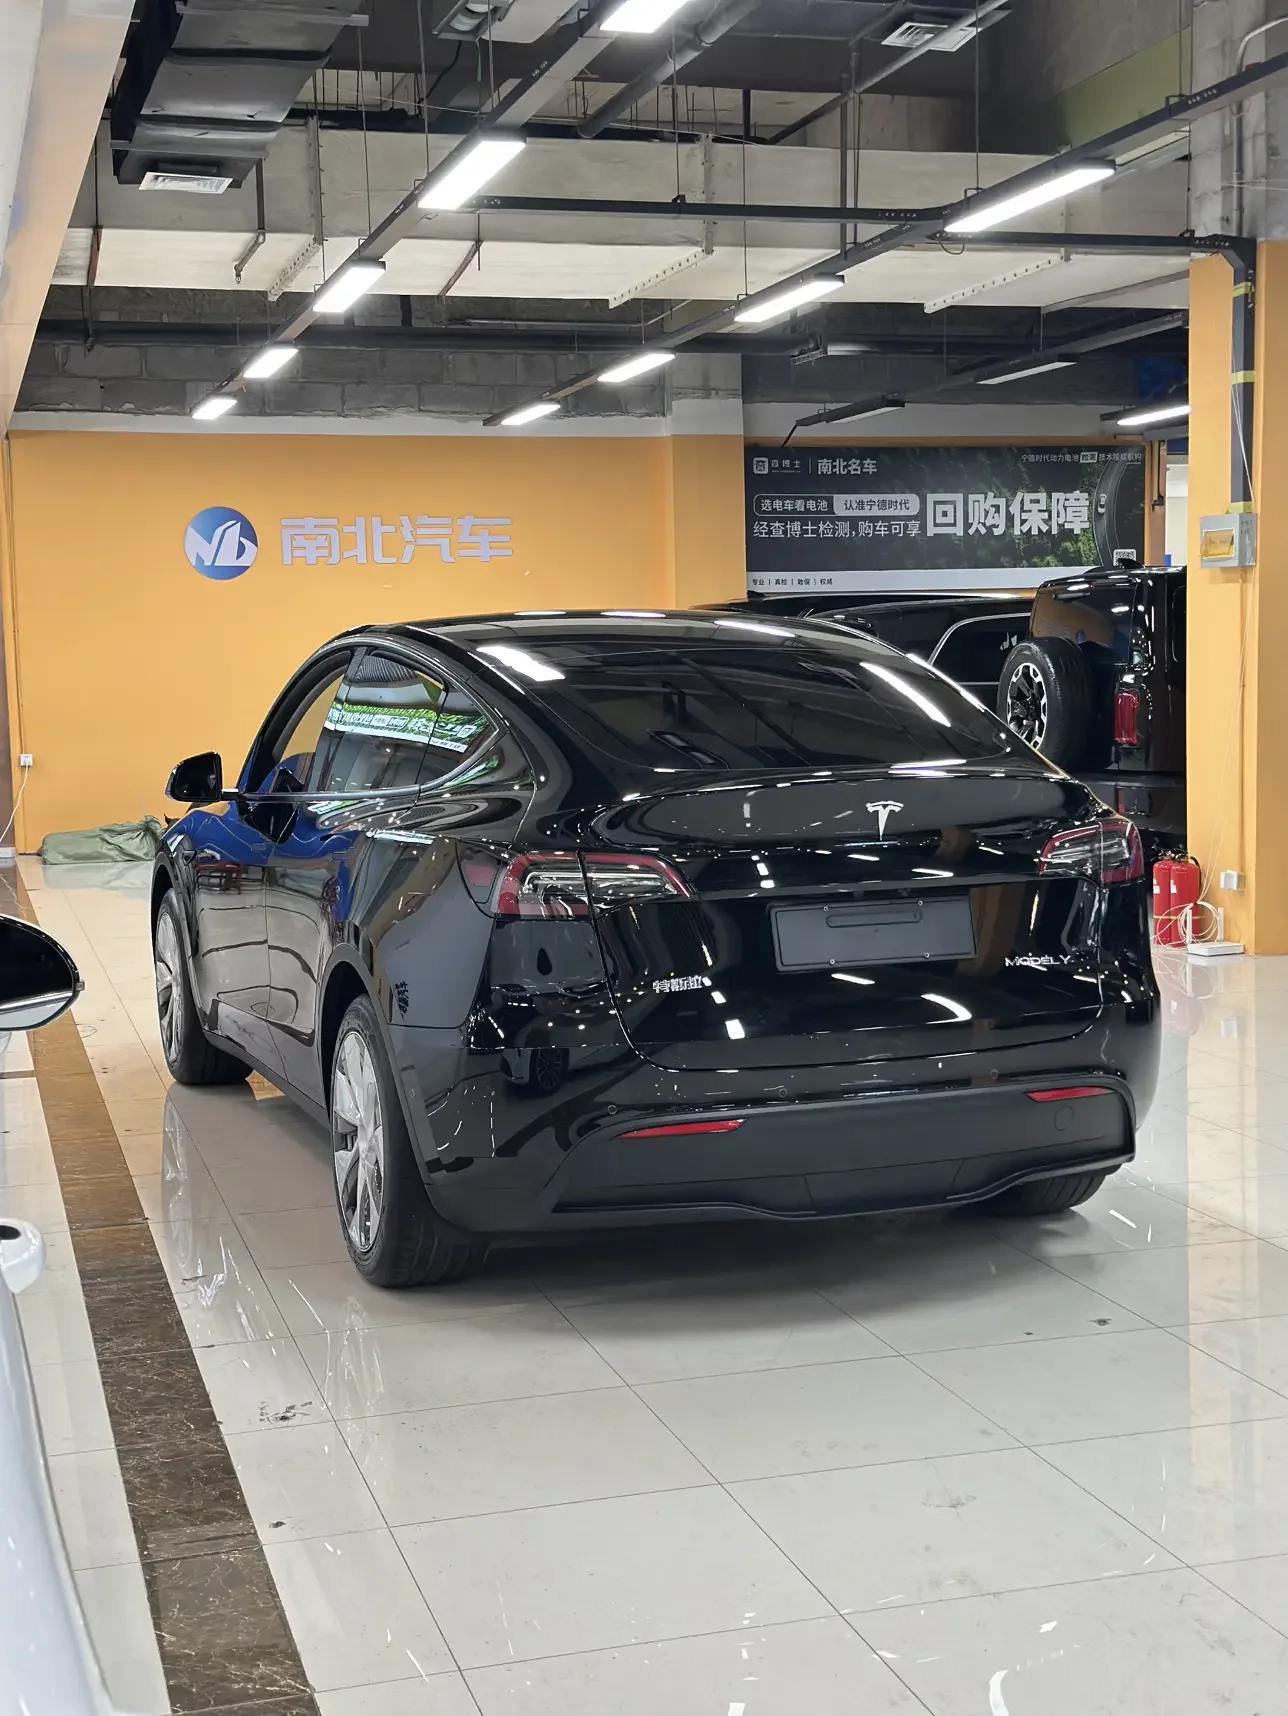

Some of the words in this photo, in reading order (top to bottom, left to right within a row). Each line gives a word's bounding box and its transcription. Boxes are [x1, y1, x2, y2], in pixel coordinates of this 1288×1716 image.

[817, 458, 877, 475] 南北名车
[761, 499, 828, 511] 选电车看电池
[844, 498, 910, 511] 认准宁德时代
[926, 490, 1090, 537] 回购保障
[753, 520, 922, 538] 经查博士检测，购车可享
[280, 516, 514, 565] 南北汽车
[1005, 955, 1060, 967] MODEL
[1059, 954, 1071, 964] Y
[652, 975, 702, 993] 特斯拉
